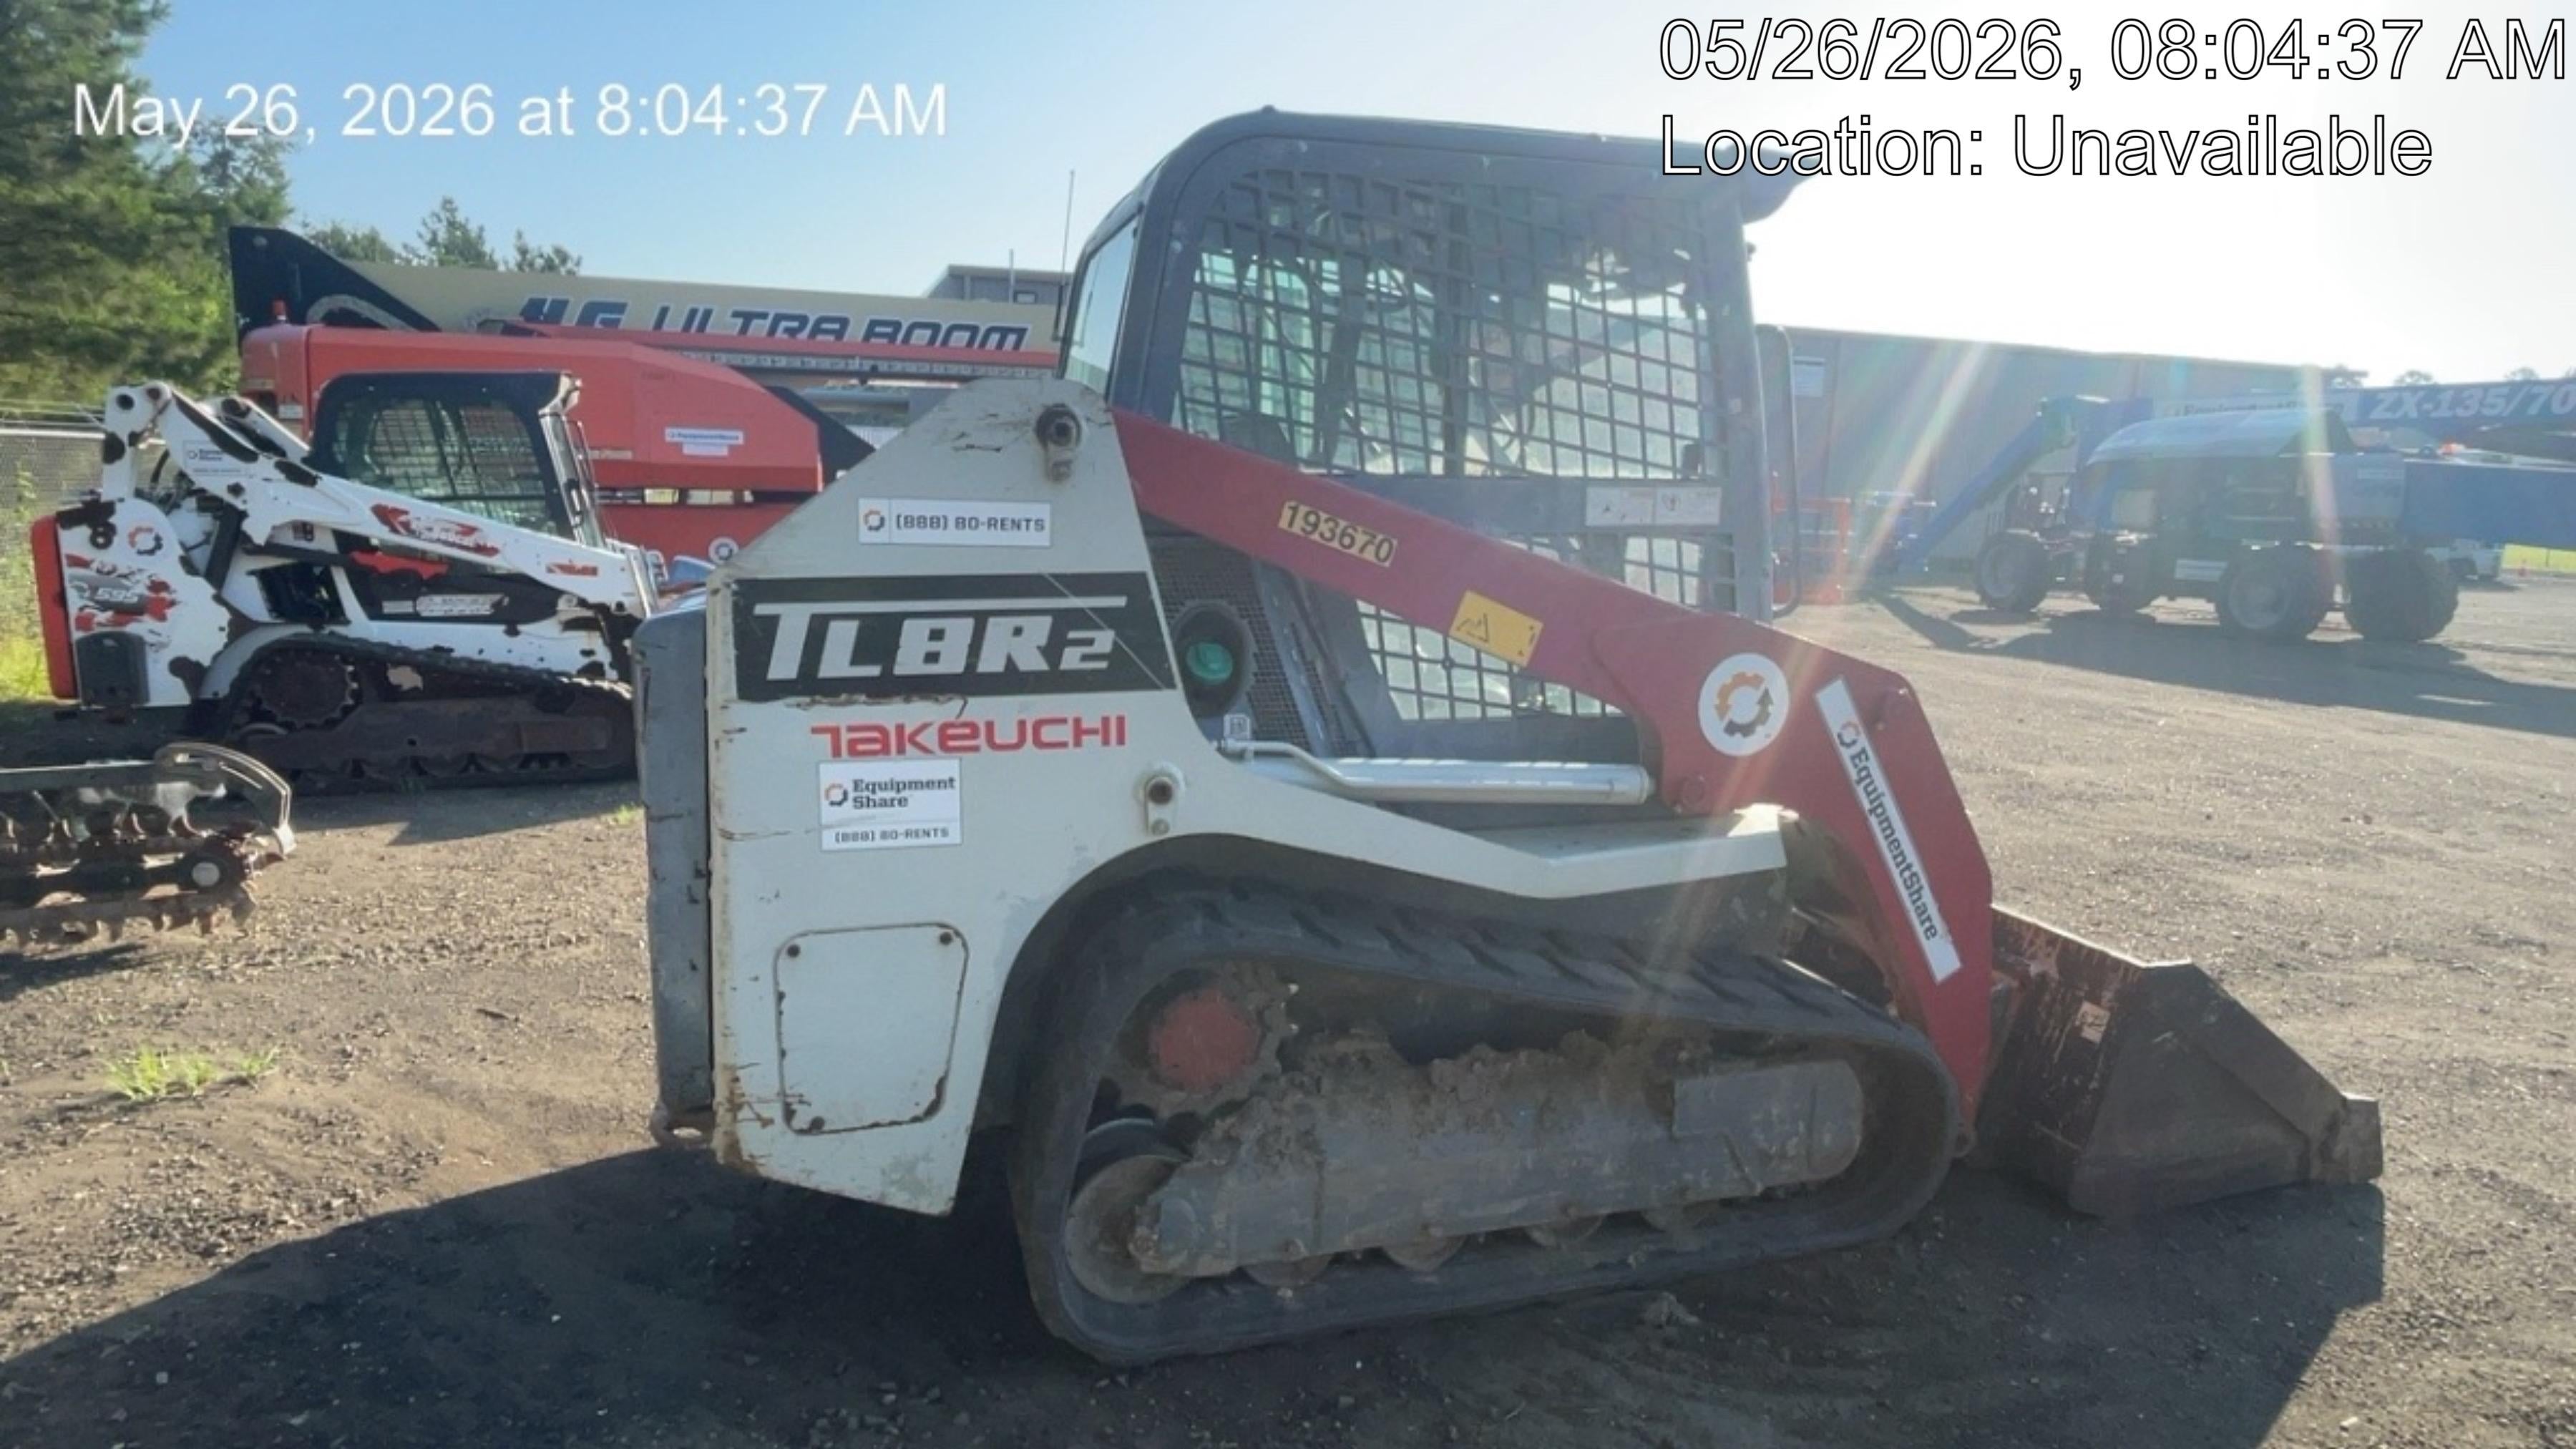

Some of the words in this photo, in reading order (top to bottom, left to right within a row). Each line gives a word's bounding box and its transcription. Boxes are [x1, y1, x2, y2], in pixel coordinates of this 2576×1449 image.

[862, 319, 1028, 351] BOOM
[2368, 381, 2576, 421] ZX-135/70
[1287, 504, 1395, 564] 193670
[852, 776, 956, 794] Equipment
[852, 795, 909, 809] Share
[1849, 747, 1938, 942] EquipmentShare
